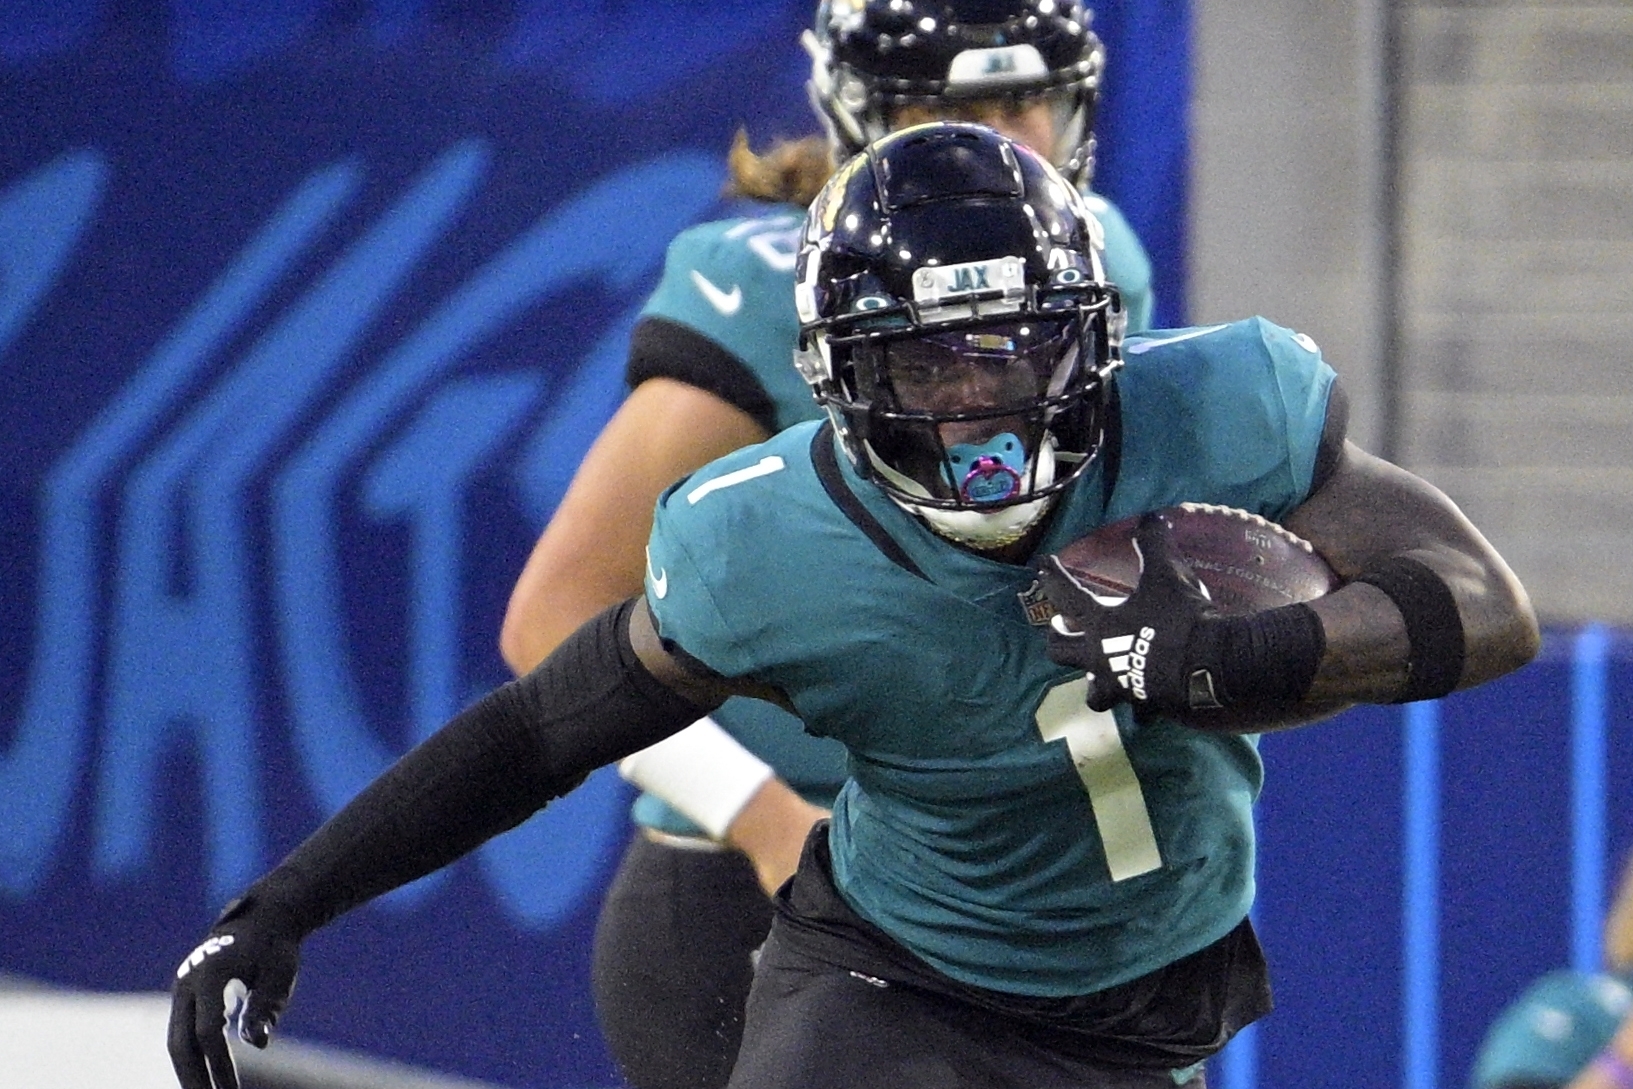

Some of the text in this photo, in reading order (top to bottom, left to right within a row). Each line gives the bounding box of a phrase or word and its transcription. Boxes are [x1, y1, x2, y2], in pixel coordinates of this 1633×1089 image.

[947, 265, 991, 293] JAX
[686, 455, 786, 505] 1
[1128, 626, 1156, 700] adidas
[1035, 675, 1163, 882] 1
